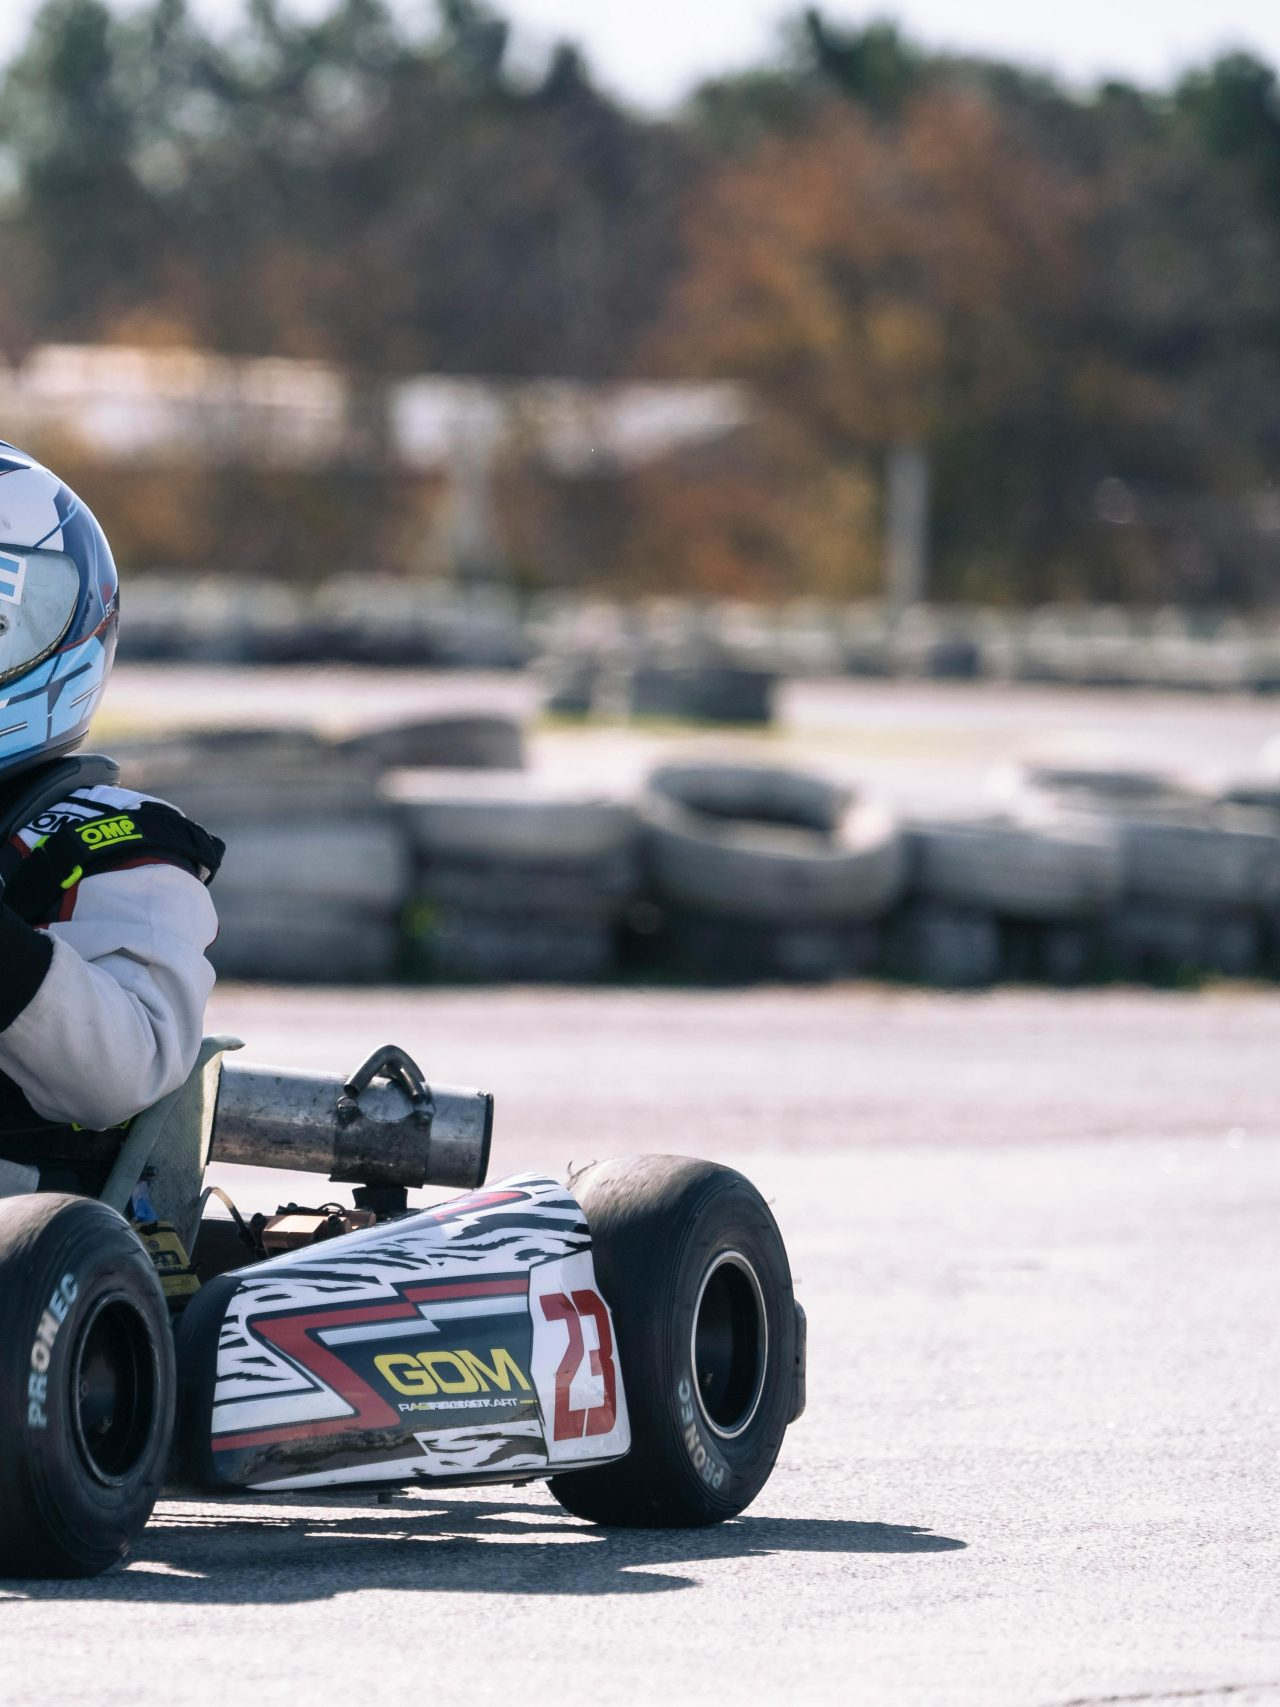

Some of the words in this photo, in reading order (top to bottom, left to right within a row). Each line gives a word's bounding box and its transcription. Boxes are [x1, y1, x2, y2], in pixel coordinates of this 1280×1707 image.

[80, 818, 137, 844] OMP
[373, 1348, 532, 1396] GOM
[540, 1289, 617, 1442] 23
